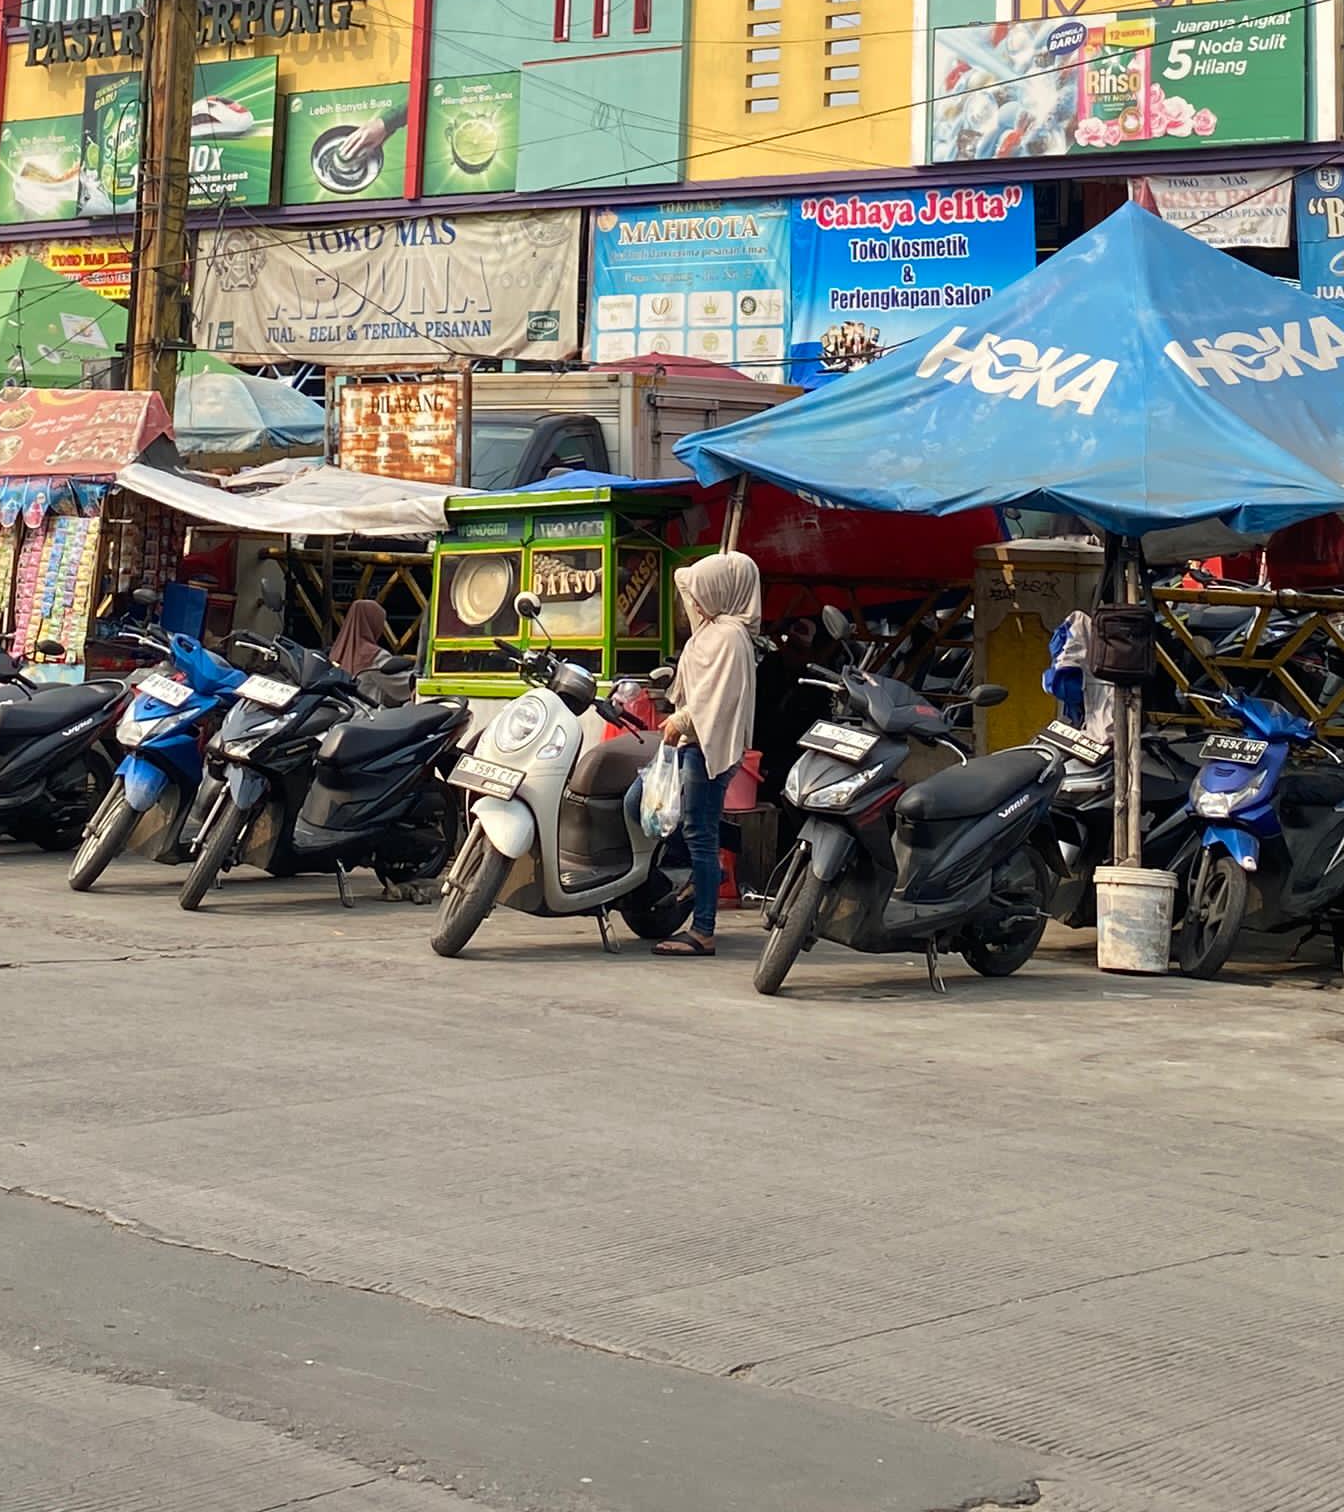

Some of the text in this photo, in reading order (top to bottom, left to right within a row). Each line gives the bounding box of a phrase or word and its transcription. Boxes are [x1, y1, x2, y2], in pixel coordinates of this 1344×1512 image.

[1172, 12, 1291, 34] Juaranya Angkat
[25, 9, 145, 67] PASAR
[1049, 33, 1083, 50] BARU!
[1163, 35, 1287, 80] 5 Noda Sulit
[1193, 59, 1247, 76] Hilang
[1086, 69, 1141, 95] Rinso
[308, 102, 334, 116] Lebih
[335, 100, 369, 115] Banyak
[1220, 175, 1248, 185] MAS
[306, 215, 457, 255] TOKO MAS
[617, 215, 760, 246] MAHKOTA
[850, 234, 969, 262] Toko Kosmetik
[903, 265, 914, 283] &
[265, 253, 495, 322] ARJUNA
[830, 287, 941, 311] Perlengkapan
[265, 319, 494, 343] JUAL BELI & TERIMA PESANAN
[916, 326, 1120, 416] HOKA
[370, 392, 445, 414] DILARANG
[533, 571, 596, 597] BAKSO
[617, 552, 656, 610] BAKSO
